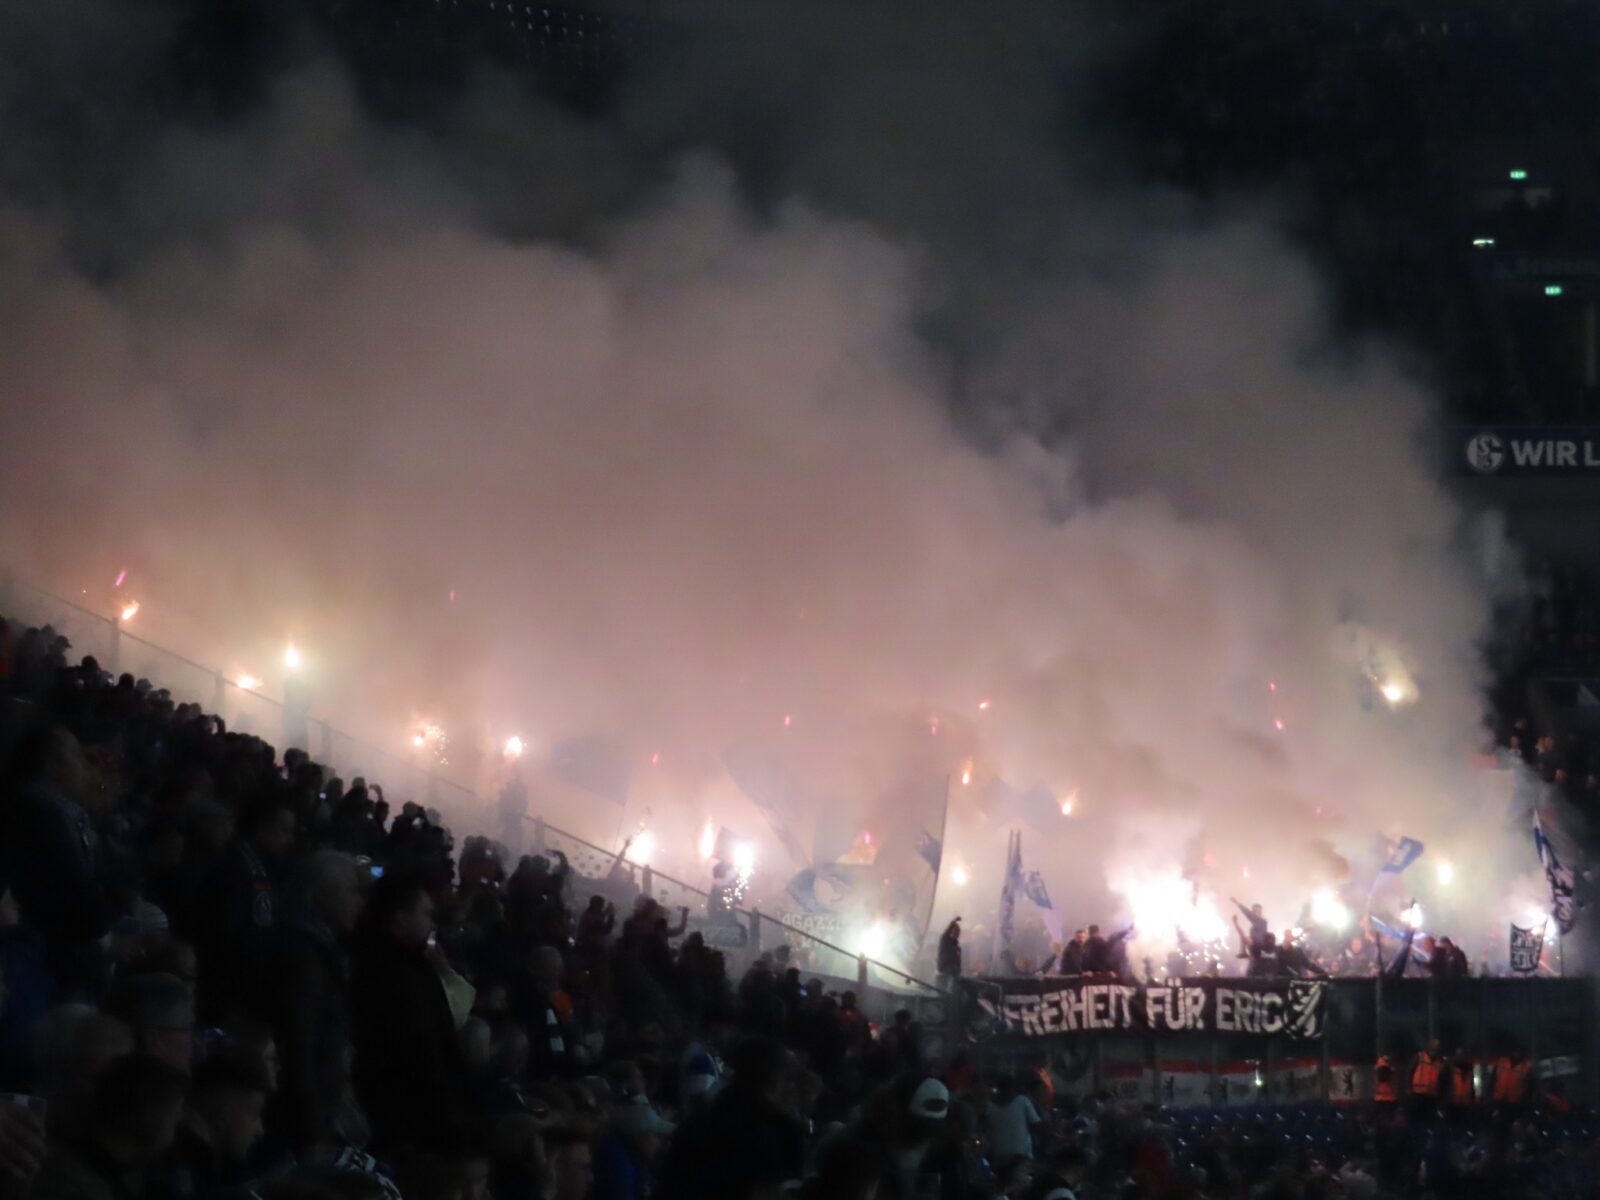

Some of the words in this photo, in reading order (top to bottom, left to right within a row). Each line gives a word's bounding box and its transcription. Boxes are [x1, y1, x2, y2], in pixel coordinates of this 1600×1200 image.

[1511, 440, 1577, 466] WIR
[1584, 440, 1600, 466] L
[1001, 984, 1138, 1035] FREIHEIT
[1146, 978, 1205, 1030] FÜR
[1216, 988, 1283, 1032] ERIC
